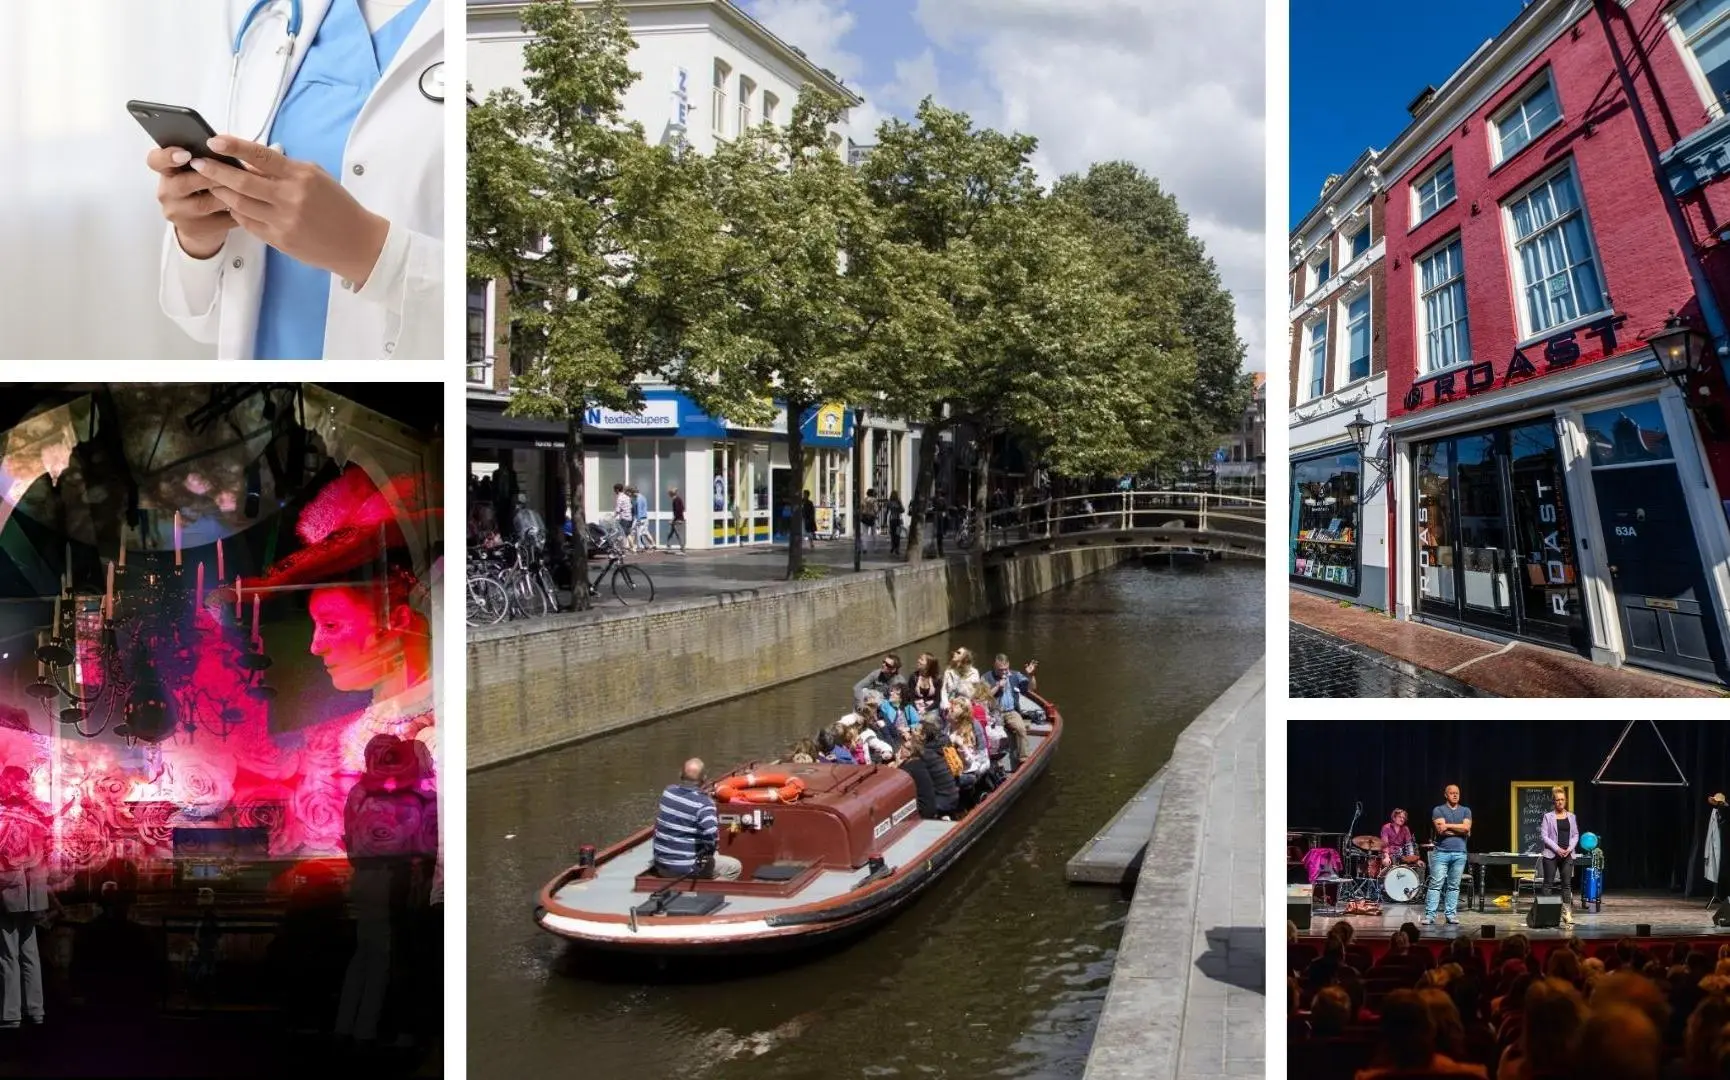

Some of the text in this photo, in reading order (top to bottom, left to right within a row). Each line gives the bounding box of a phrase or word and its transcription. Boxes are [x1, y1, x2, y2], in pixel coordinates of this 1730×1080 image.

[1433, 313, 1628, 401] ROAST
[604, 415, 670, 425] textielSupers
[1418, 489, 1430, 593] ROAST
[1536, 479, 1570, 616] ROAST
[1615, 526, 1637, 537] 63A
